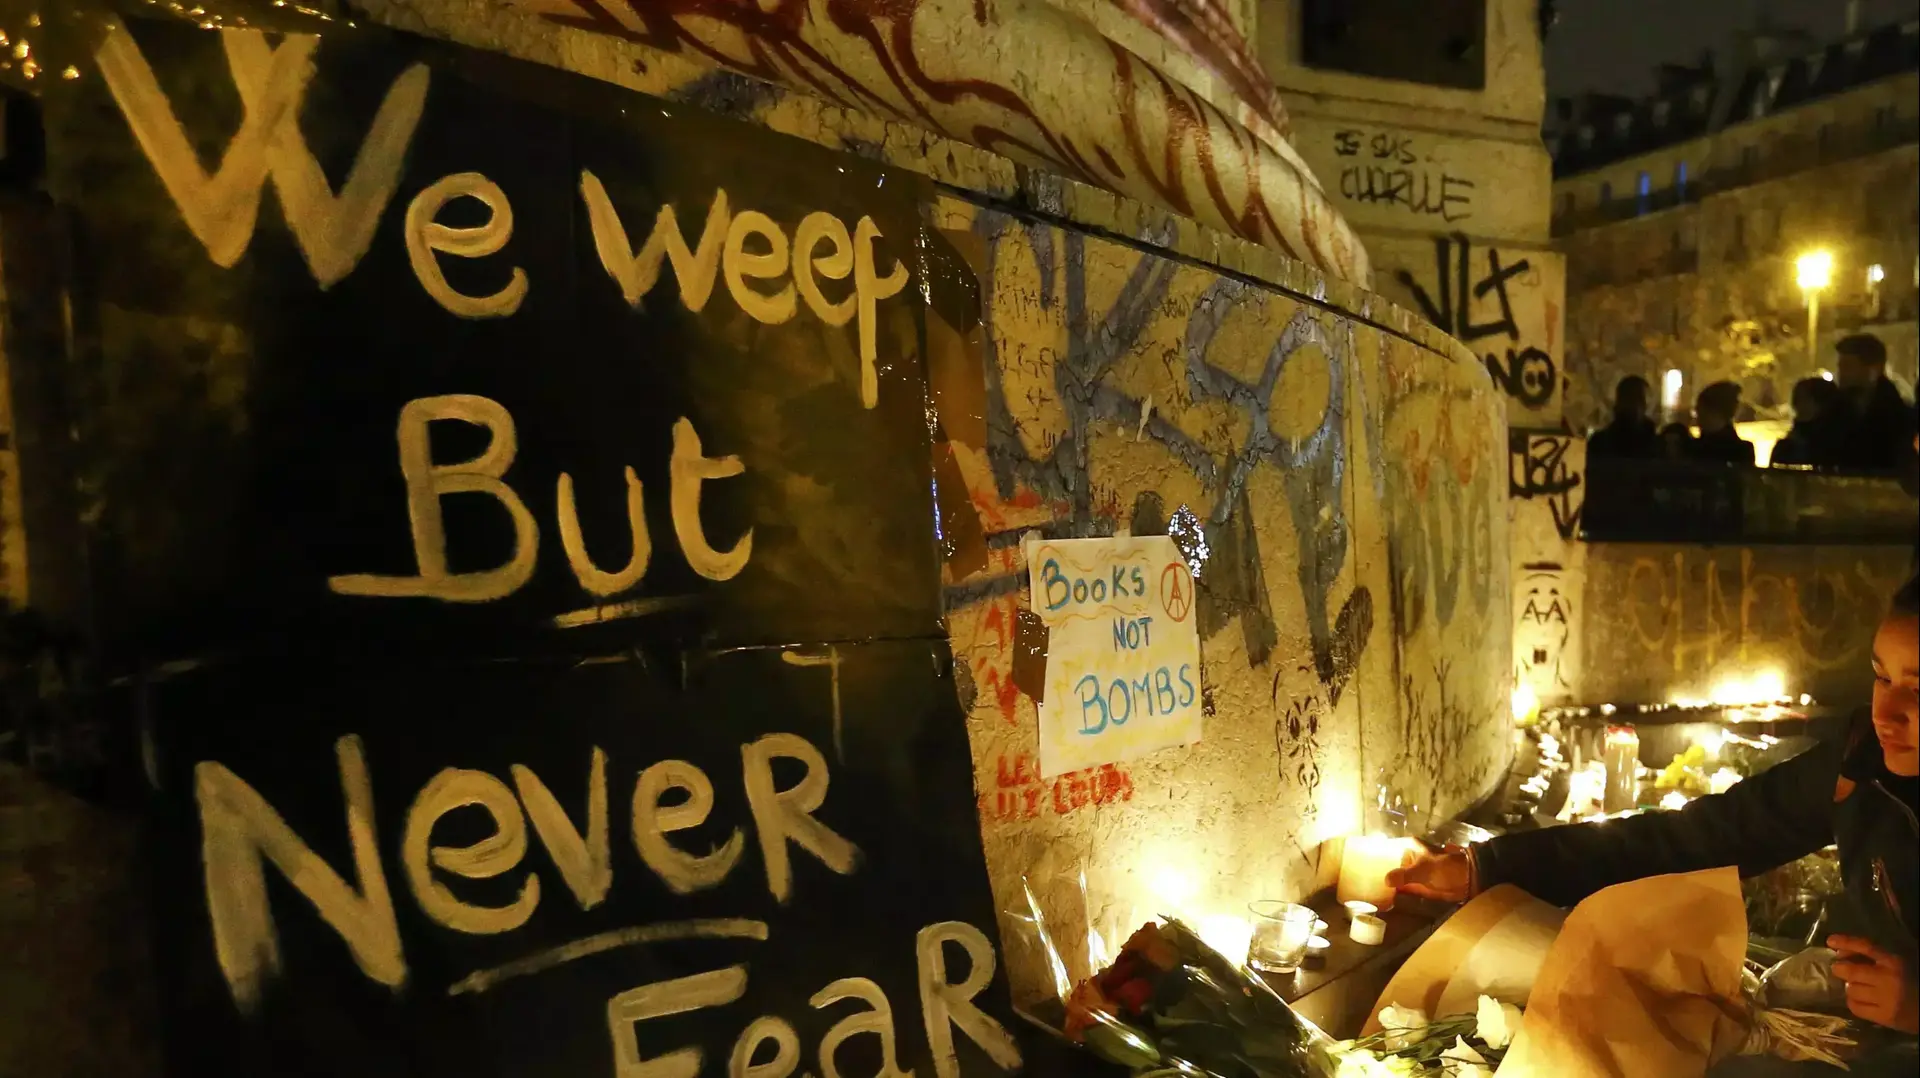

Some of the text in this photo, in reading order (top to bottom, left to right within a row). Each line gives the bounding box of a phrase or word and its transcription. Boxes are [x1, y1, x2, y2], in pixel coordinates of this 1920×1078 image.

[95, 22, 529, 318] We
[580, 169, 909, 410] weep
[328, 394, 753, 603] But
[1074, 663, 1195, 735] BOMBS
[1113, 616, 1154, 652] NOT
